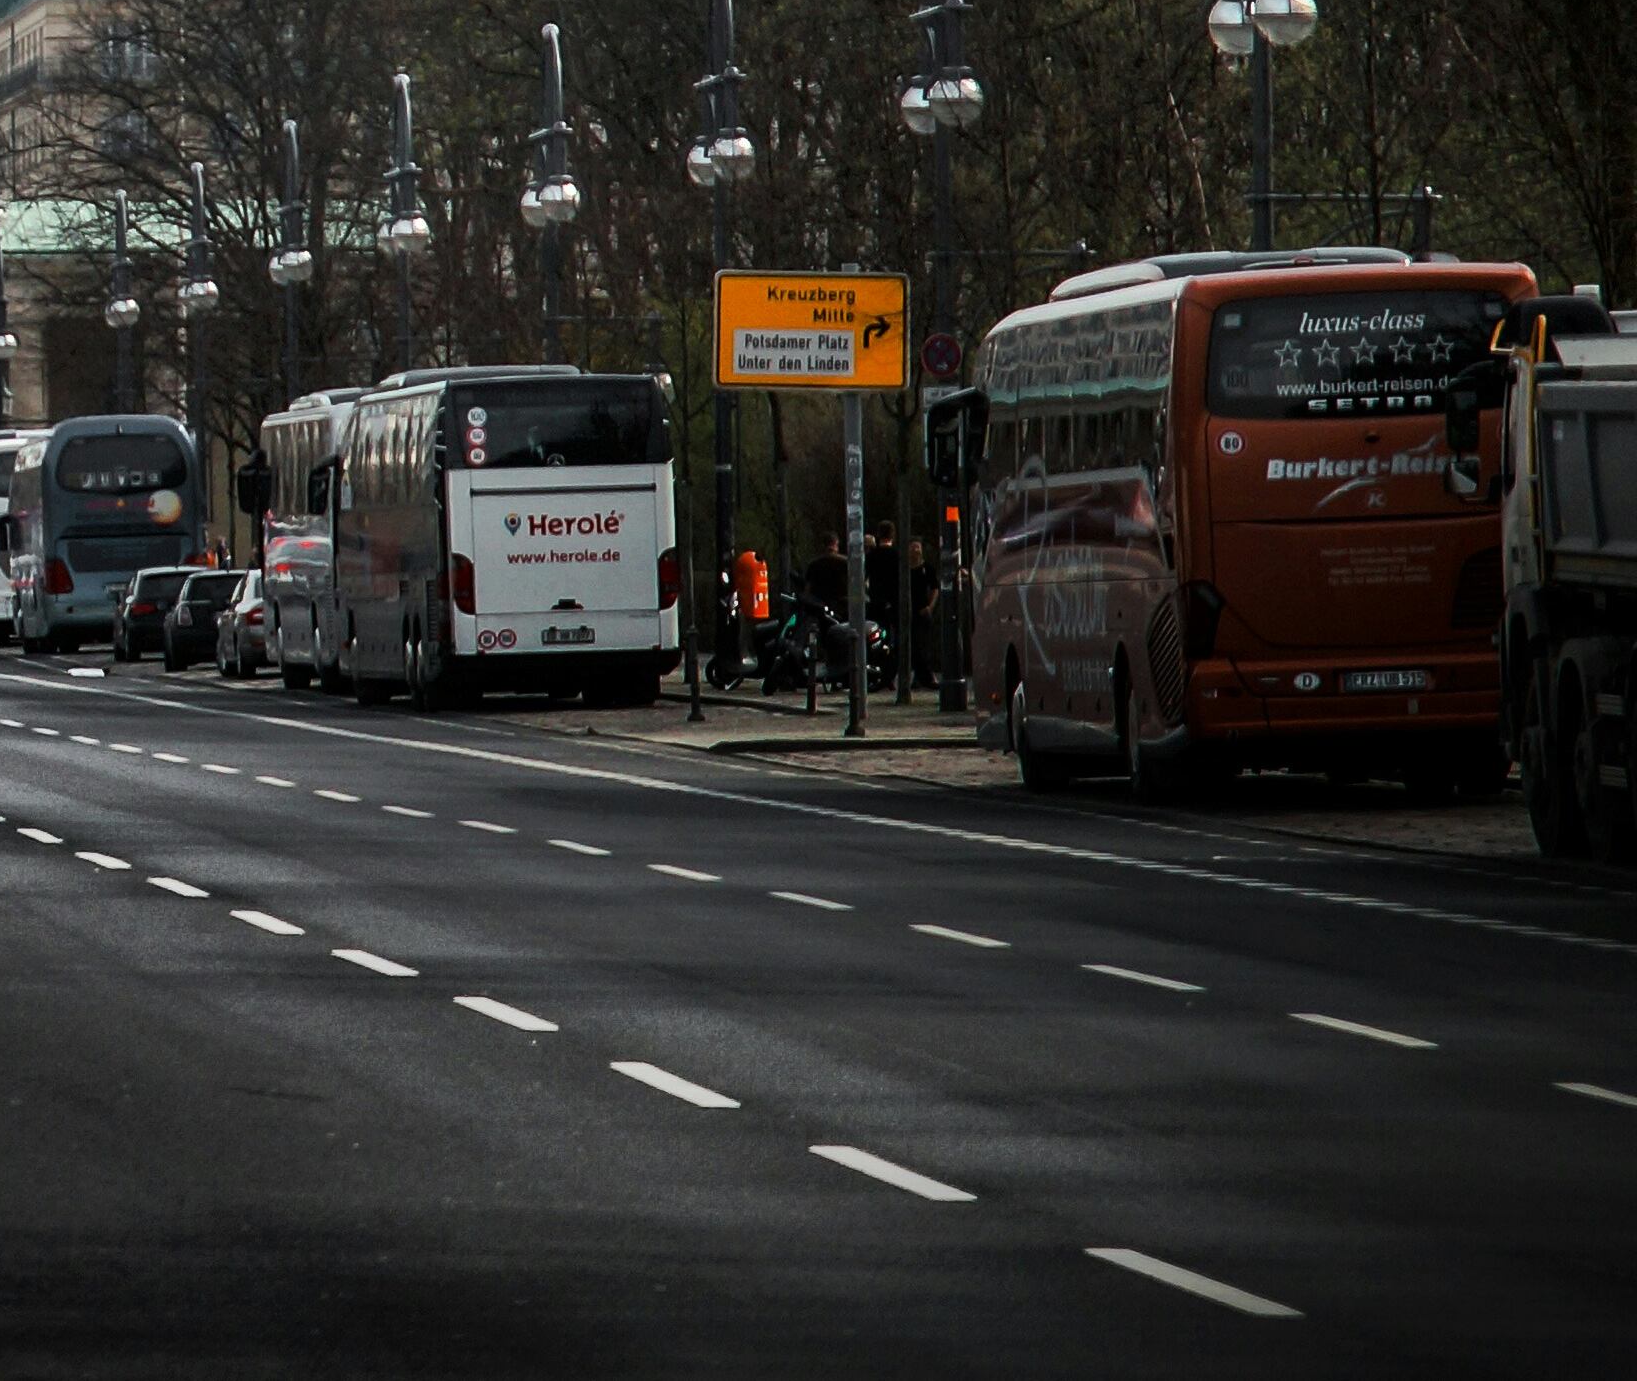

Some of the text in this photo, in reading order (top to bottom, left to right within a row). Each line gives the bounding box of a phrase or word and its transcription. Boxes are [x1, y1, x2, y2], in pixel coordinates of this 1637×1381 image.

[768, 286, 856, 305] Kreuzberg
[813, 308, 855, 323] Mitte
[1298, 308, 1427, 334] luxus-class
[745, 333, 849, 350] Potsdamer Platz
[738, 355, 850, 372] Unter den Linden
[1307, 395, 1434, 412] SETRA
[1266, 454, 1455, 480] Burkert-Reis
[527, 509, 621, 536] Herolé
[507, 548, 621, 564] www.herole.de
[1302, 674, 1313, 688] D
